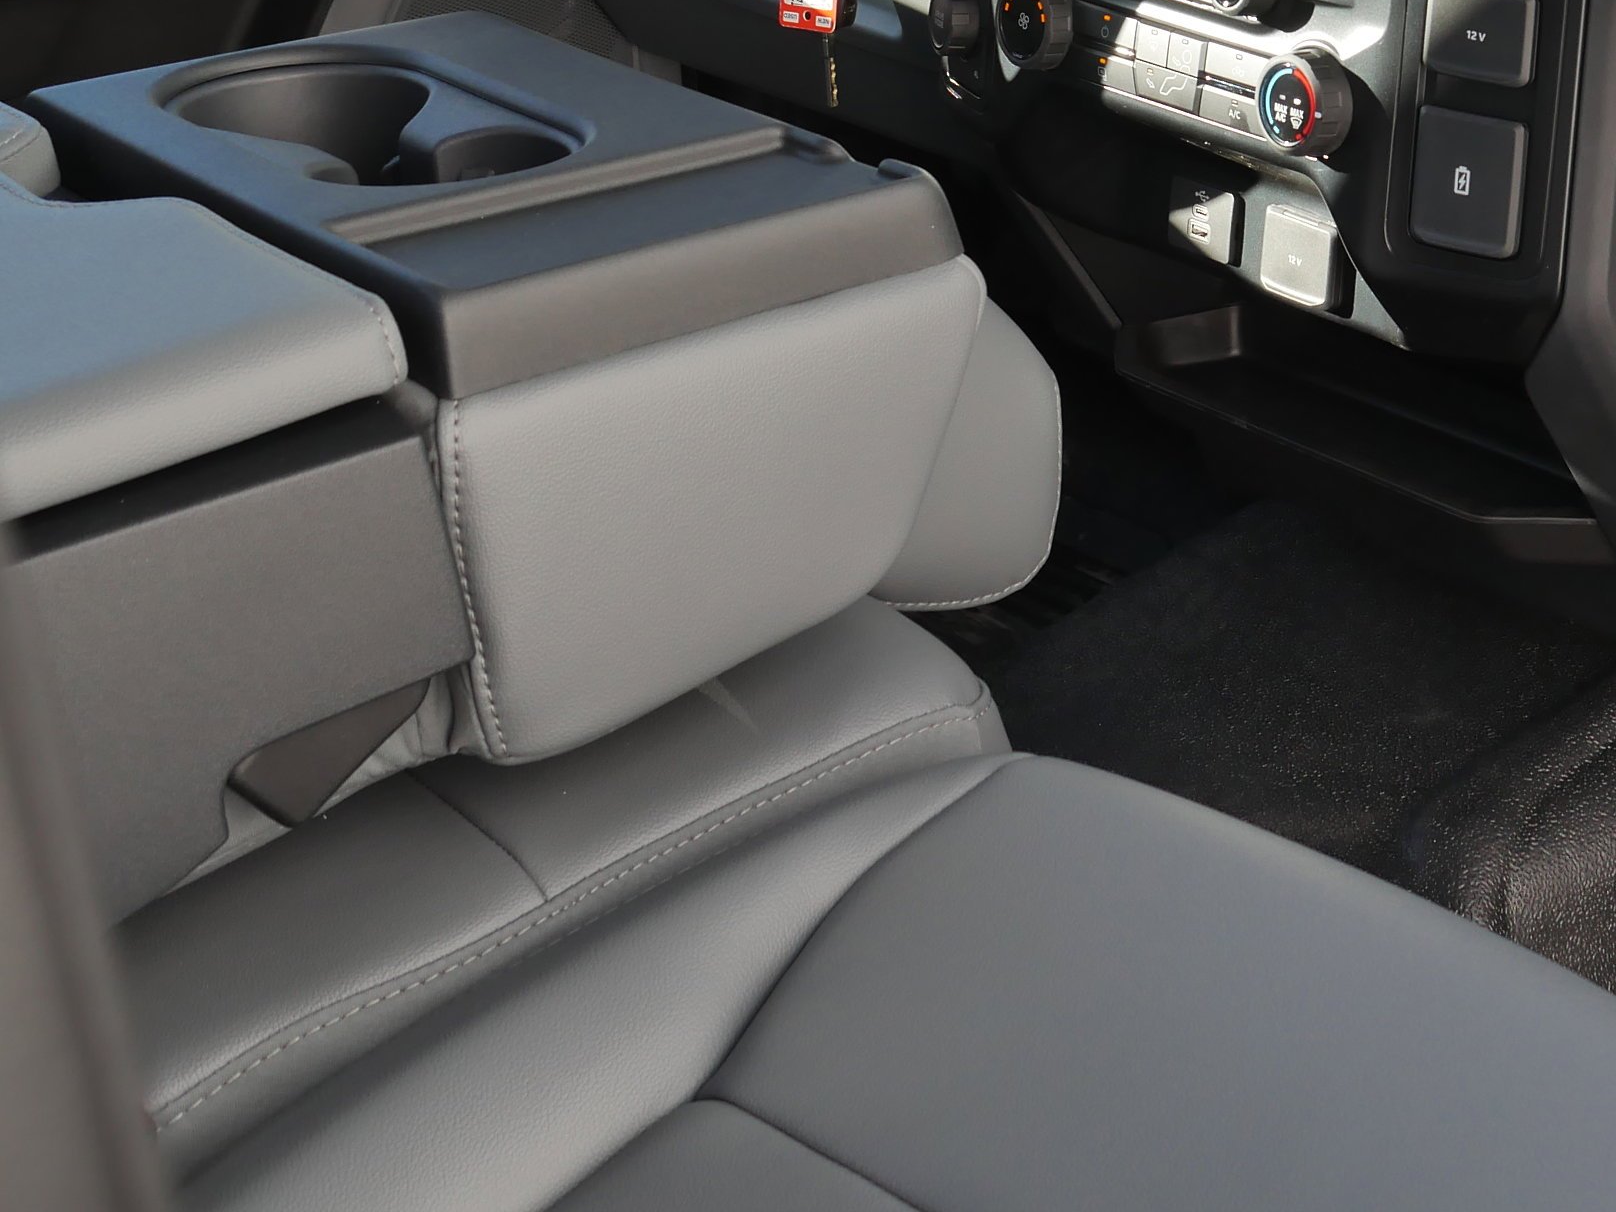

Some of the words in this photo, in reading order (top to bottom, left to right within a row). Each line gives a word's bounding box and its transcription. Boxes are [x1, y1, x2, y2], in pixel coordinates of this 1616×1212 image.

[1466, 30, 1478, 41] 12
[1478, 32, 1486, 43] V
[1228, 108, 1241, 120] A/C
[1274, 102, 1288, 115] MAX
[1290, 107, 1304, 119] MAX
[1275, 111, 1287, 123] A/C
